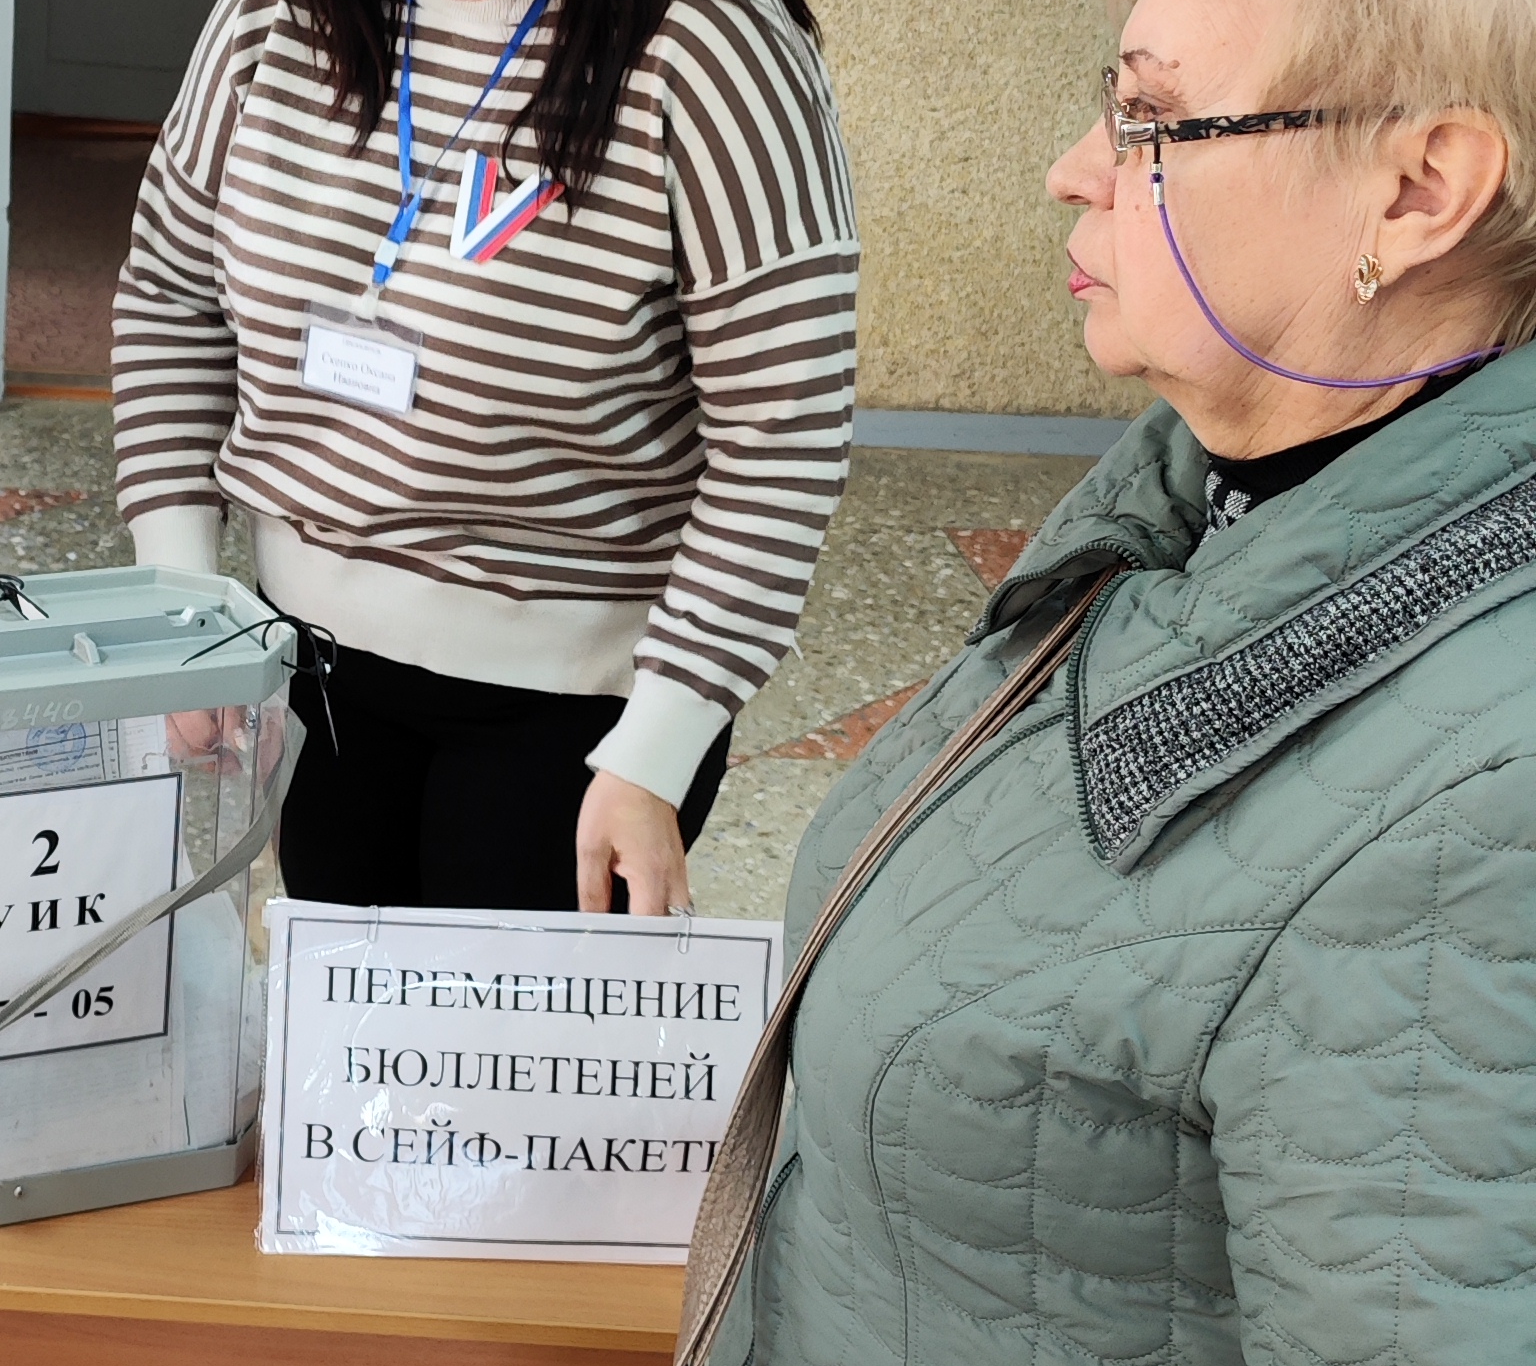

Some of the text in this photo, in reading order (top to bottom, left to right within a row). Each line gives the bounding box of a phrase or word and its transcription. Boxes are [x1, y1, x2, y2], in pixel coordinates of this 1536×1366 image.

[29, 829, 61, 877] 2
[71, 985, 115, 1020] 05
[322, 965, 742, 1024] ПЕРЕМЕЩЕНИЕ
[343, 1046, 719, 1102] БЮЛЛЕТЕНЕЙ
[301, 1123, 334, 1161] В
